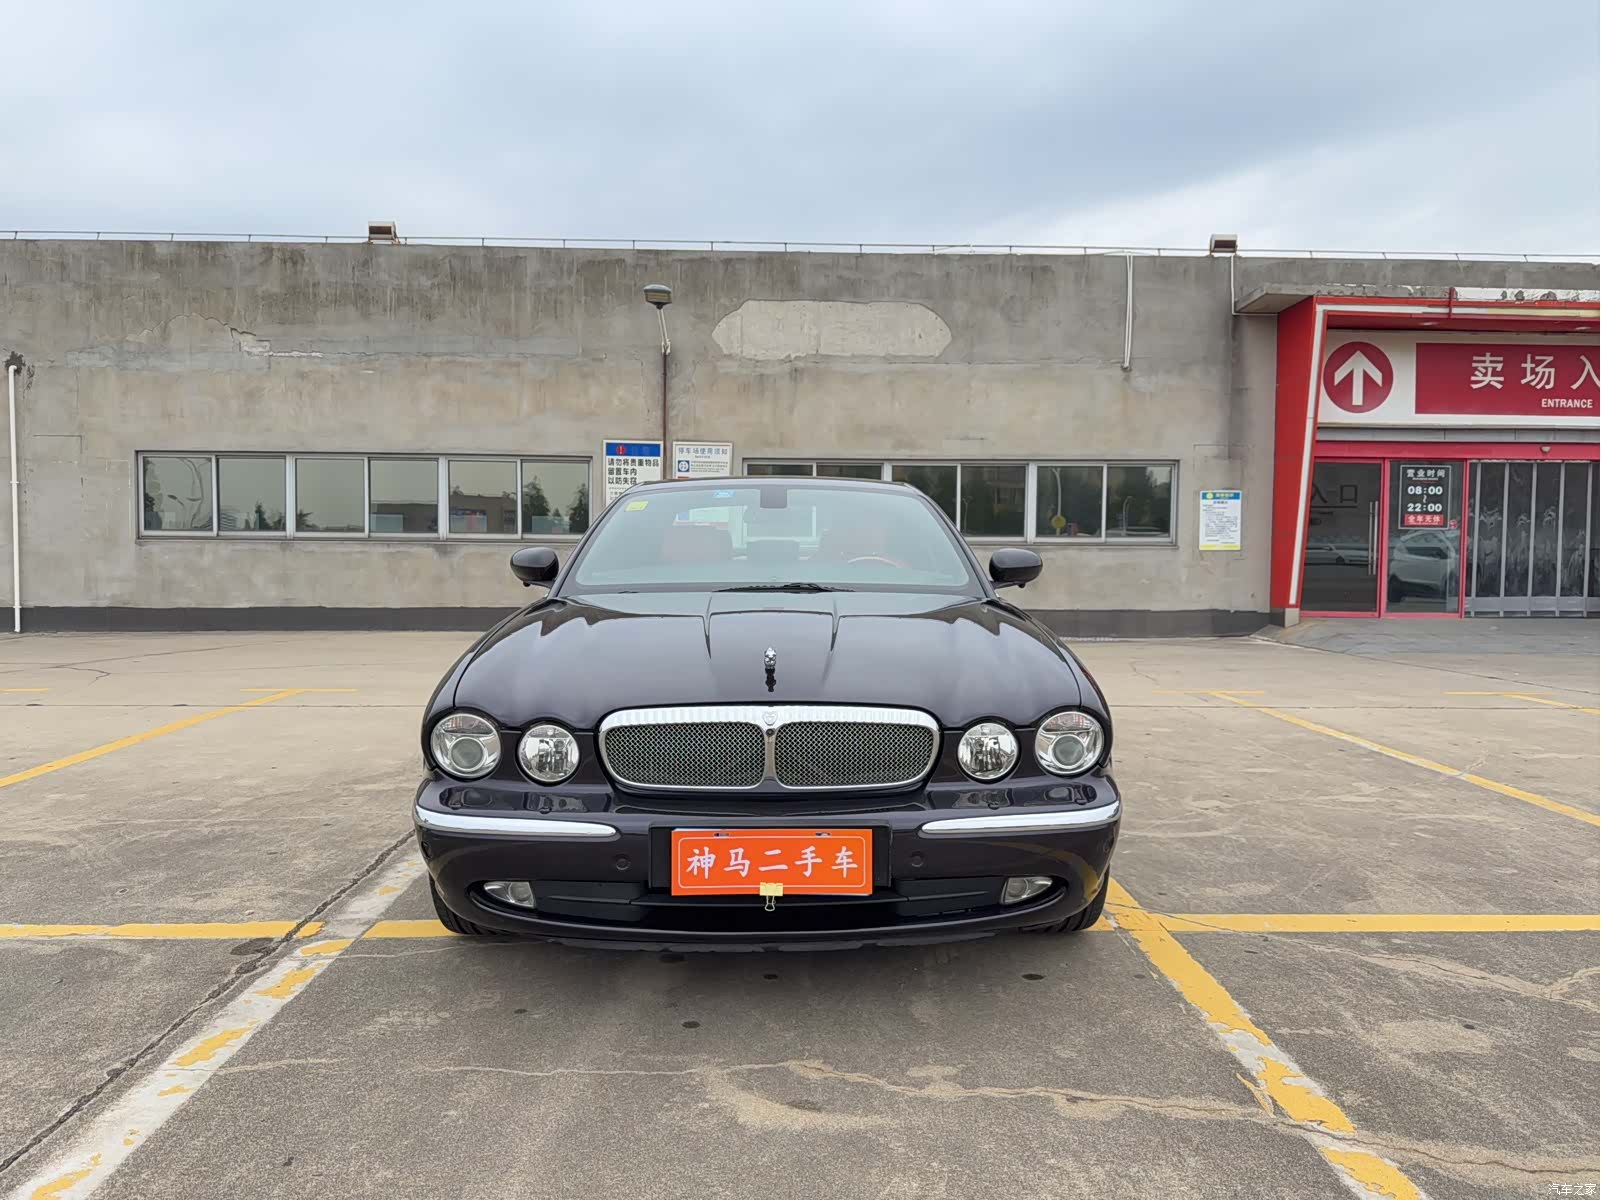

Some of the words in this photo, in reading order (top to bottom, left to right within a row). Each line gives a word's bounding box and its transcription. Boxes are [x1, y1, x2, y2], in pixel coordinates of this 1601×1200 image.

[1470, 352, 1600, 390] 卖场入
[1541, 399, 1593, 408] ENTRANCE
[678, 447, 728, 455] 停车场使用须知
[607, 457, 659, 467] 请勿将贵重物品
[607, 467, 637, 476] 留置车内
[1407, 469, 1446, 478] 营业时间
[1407, 486, 1443, 495] 08:00
[1407, 503, 1442, 512] 22:00
[686, 846, 858, 879] 神马二手车
